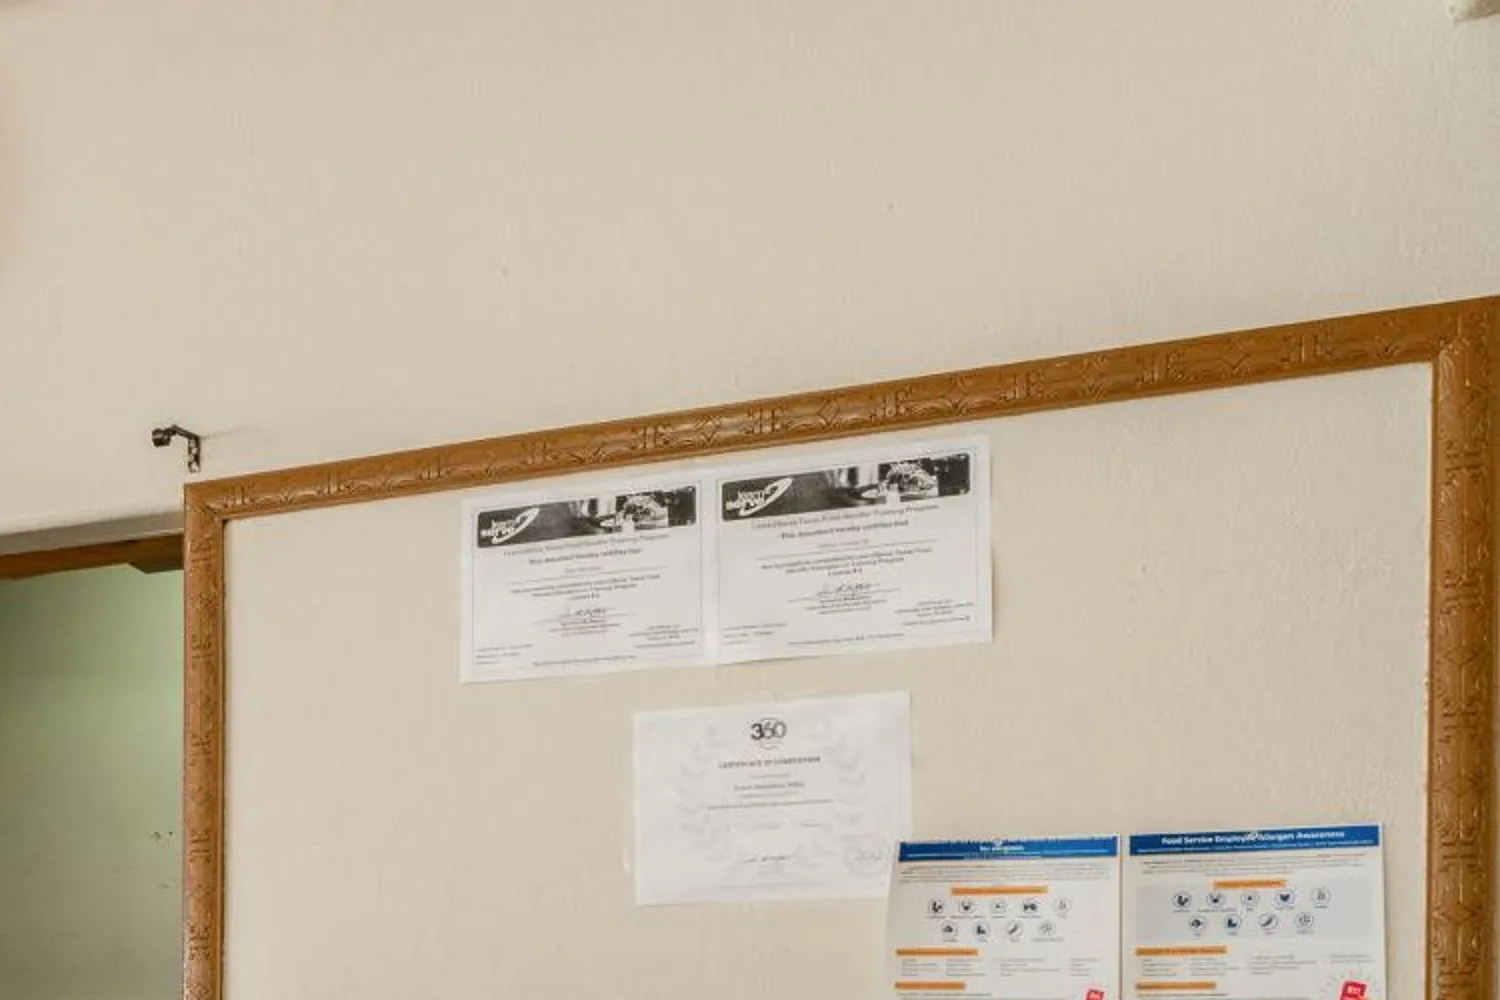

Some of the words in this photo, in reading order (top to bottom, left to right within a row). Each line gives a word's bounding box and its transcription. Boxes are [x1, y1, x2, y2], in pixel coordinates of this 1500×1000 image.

[750, 720, 787, 741] 360
[1161, 836, 1183, 845] Food
[1183, 835, 1213, 845] Service
[1296, 830, 1345, 840] Awareness
